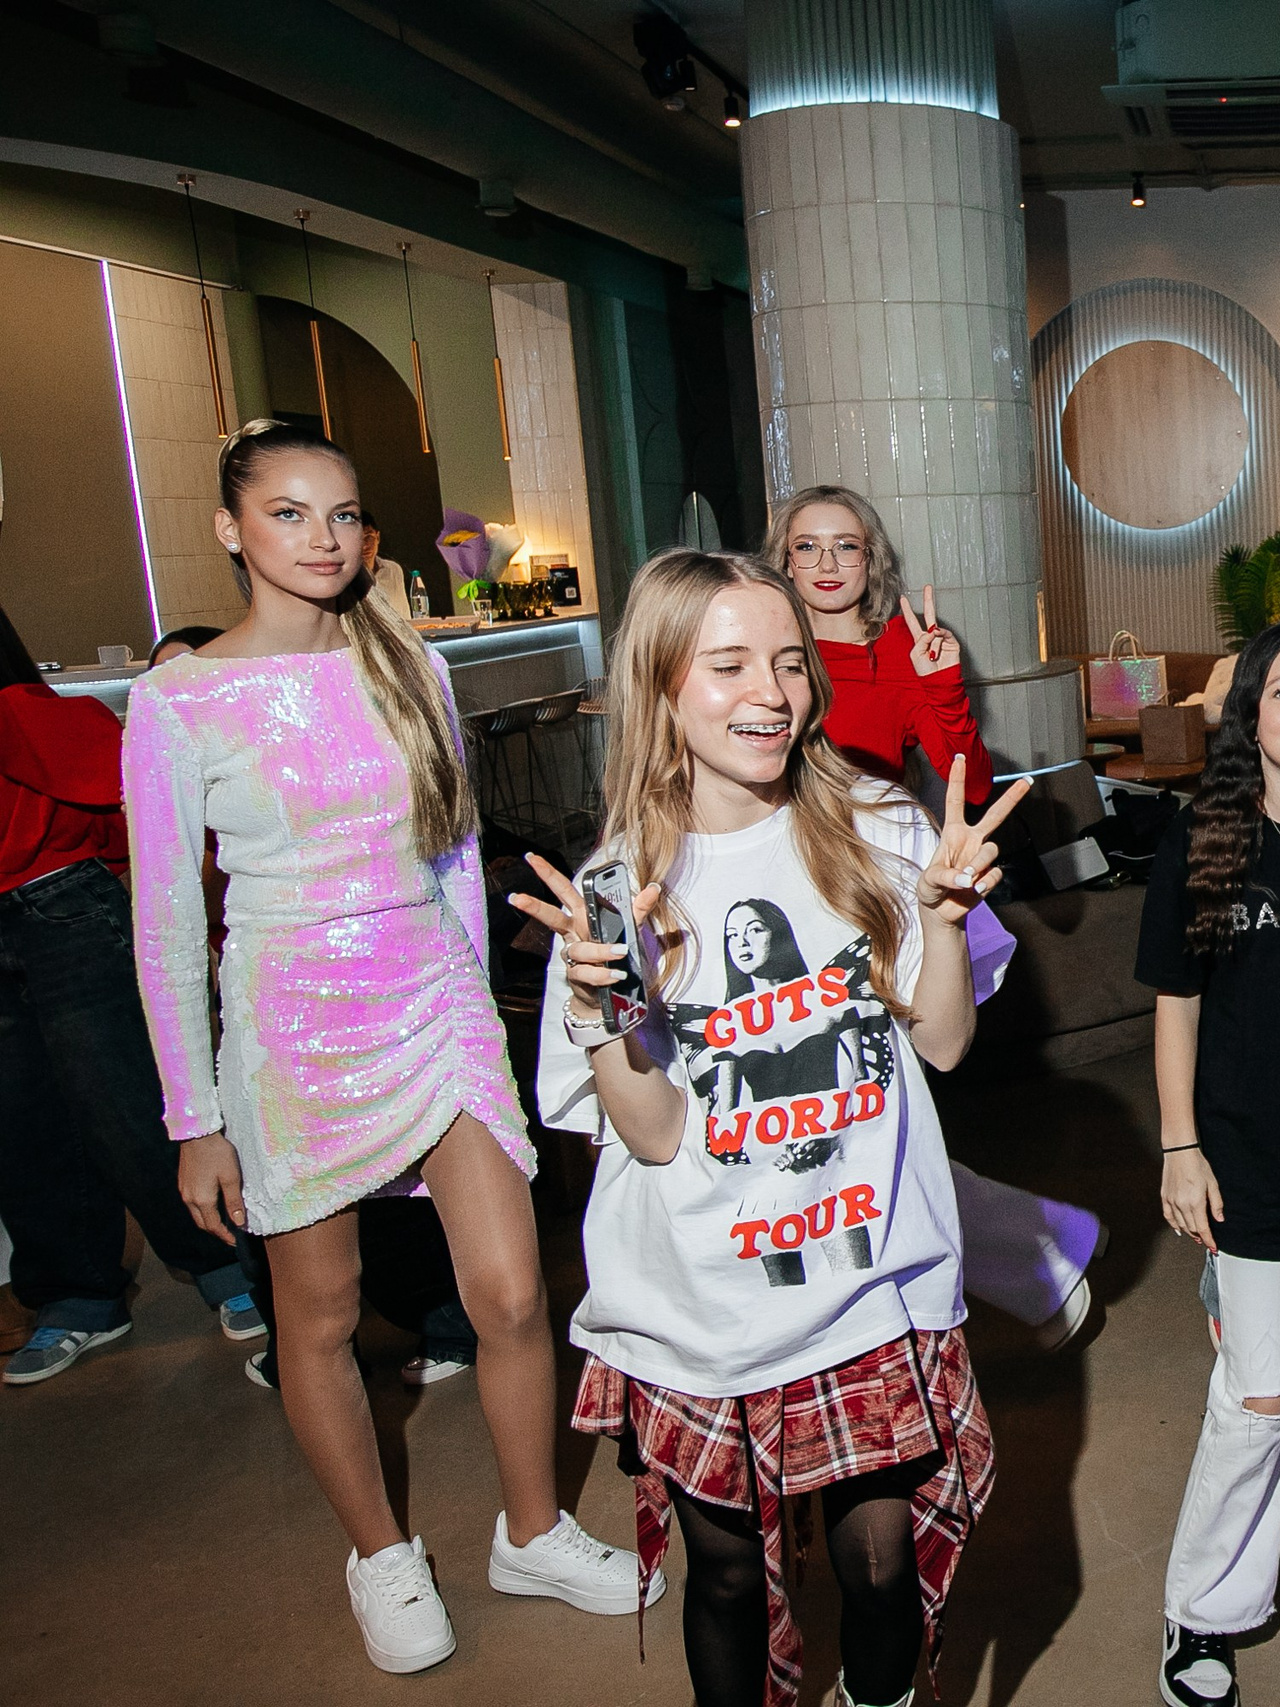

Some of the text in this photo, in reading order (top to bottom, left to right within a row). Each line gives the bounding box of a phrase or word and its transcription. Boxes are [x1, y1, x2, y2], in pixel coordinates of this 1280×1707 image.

[704, 967, 849, 1048] GUTS
[706, 1083, 885, 1155] WORLD
[730, 1183, 881, 1260] TOUR
